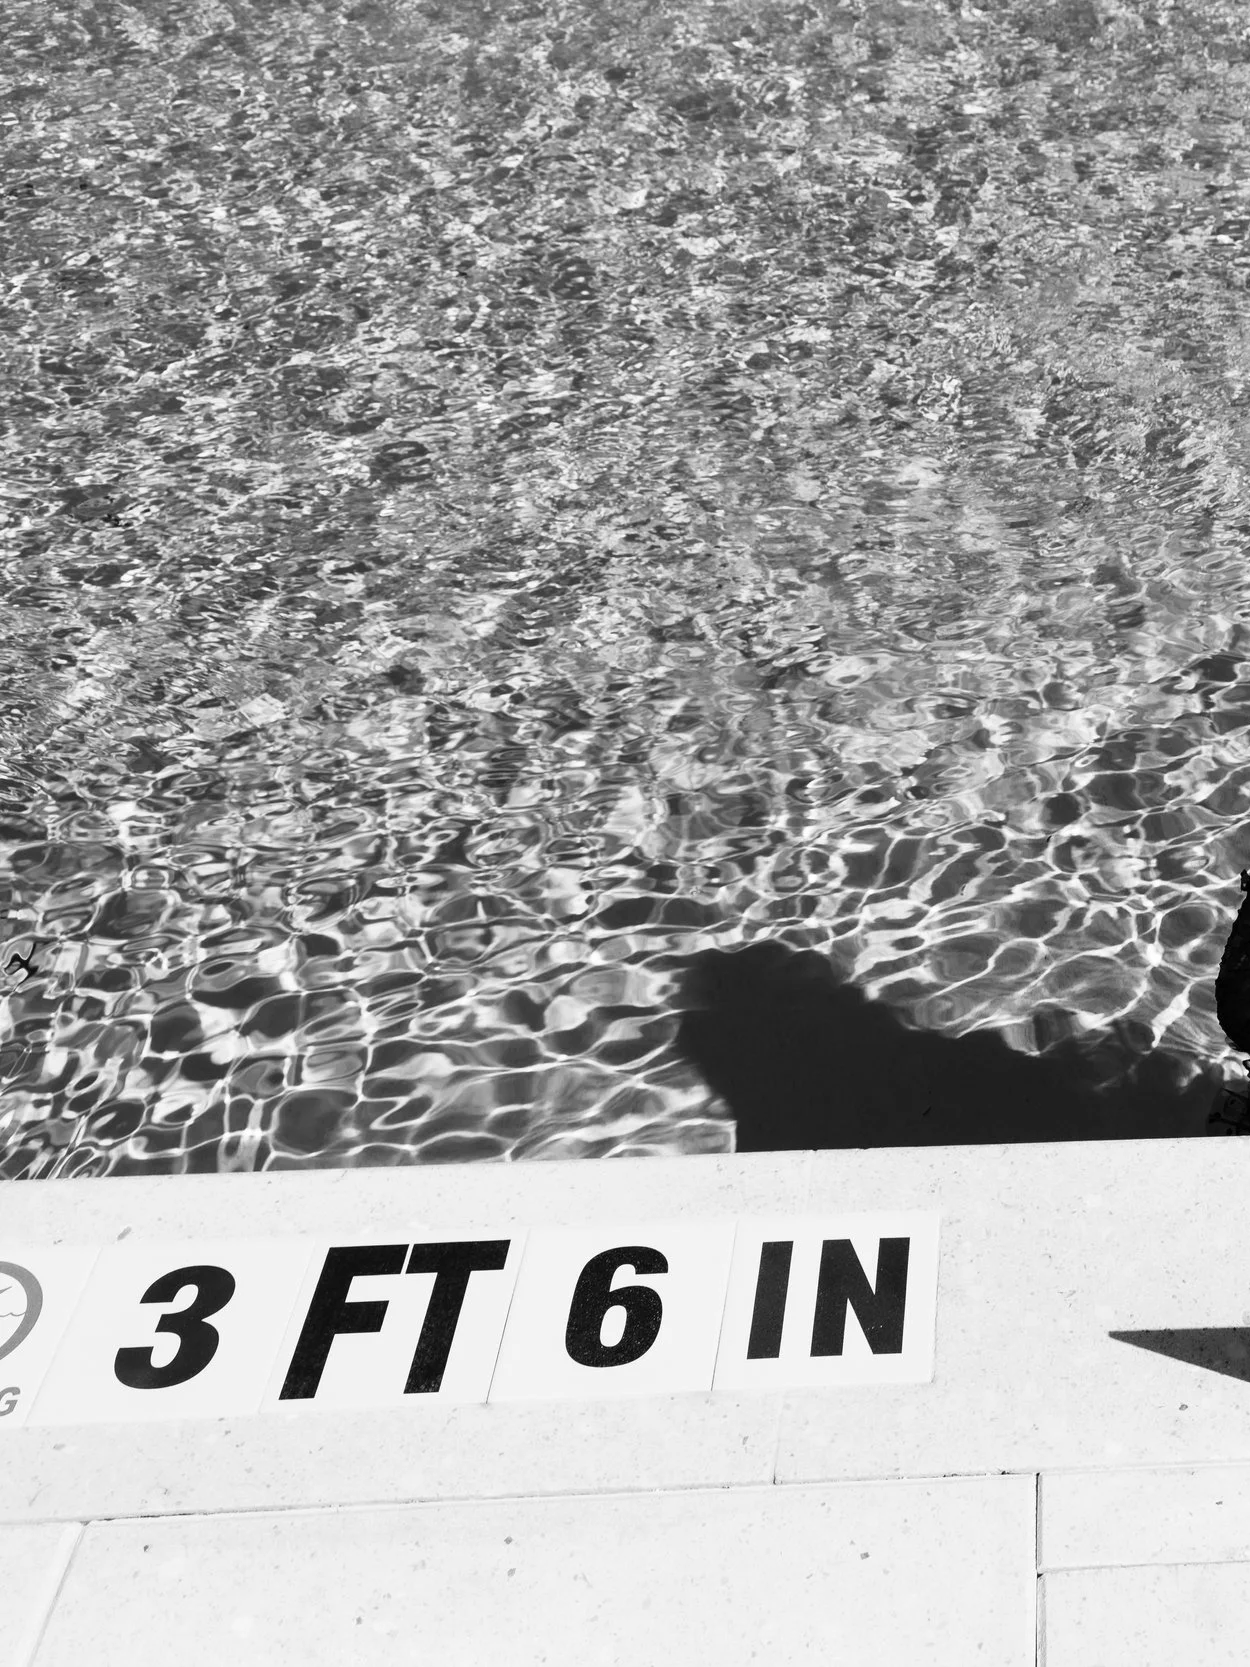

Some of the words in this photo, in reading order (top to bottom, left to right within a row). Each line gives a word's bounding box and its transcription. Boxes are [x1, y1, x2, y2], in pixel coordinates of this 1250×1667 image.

[114, 1265, 236, 1390] 3
[278, 1239, 512, 1401] FT
[565, 1245, 669, 1368] 6
[746, 1236, 911, 1360] IN
